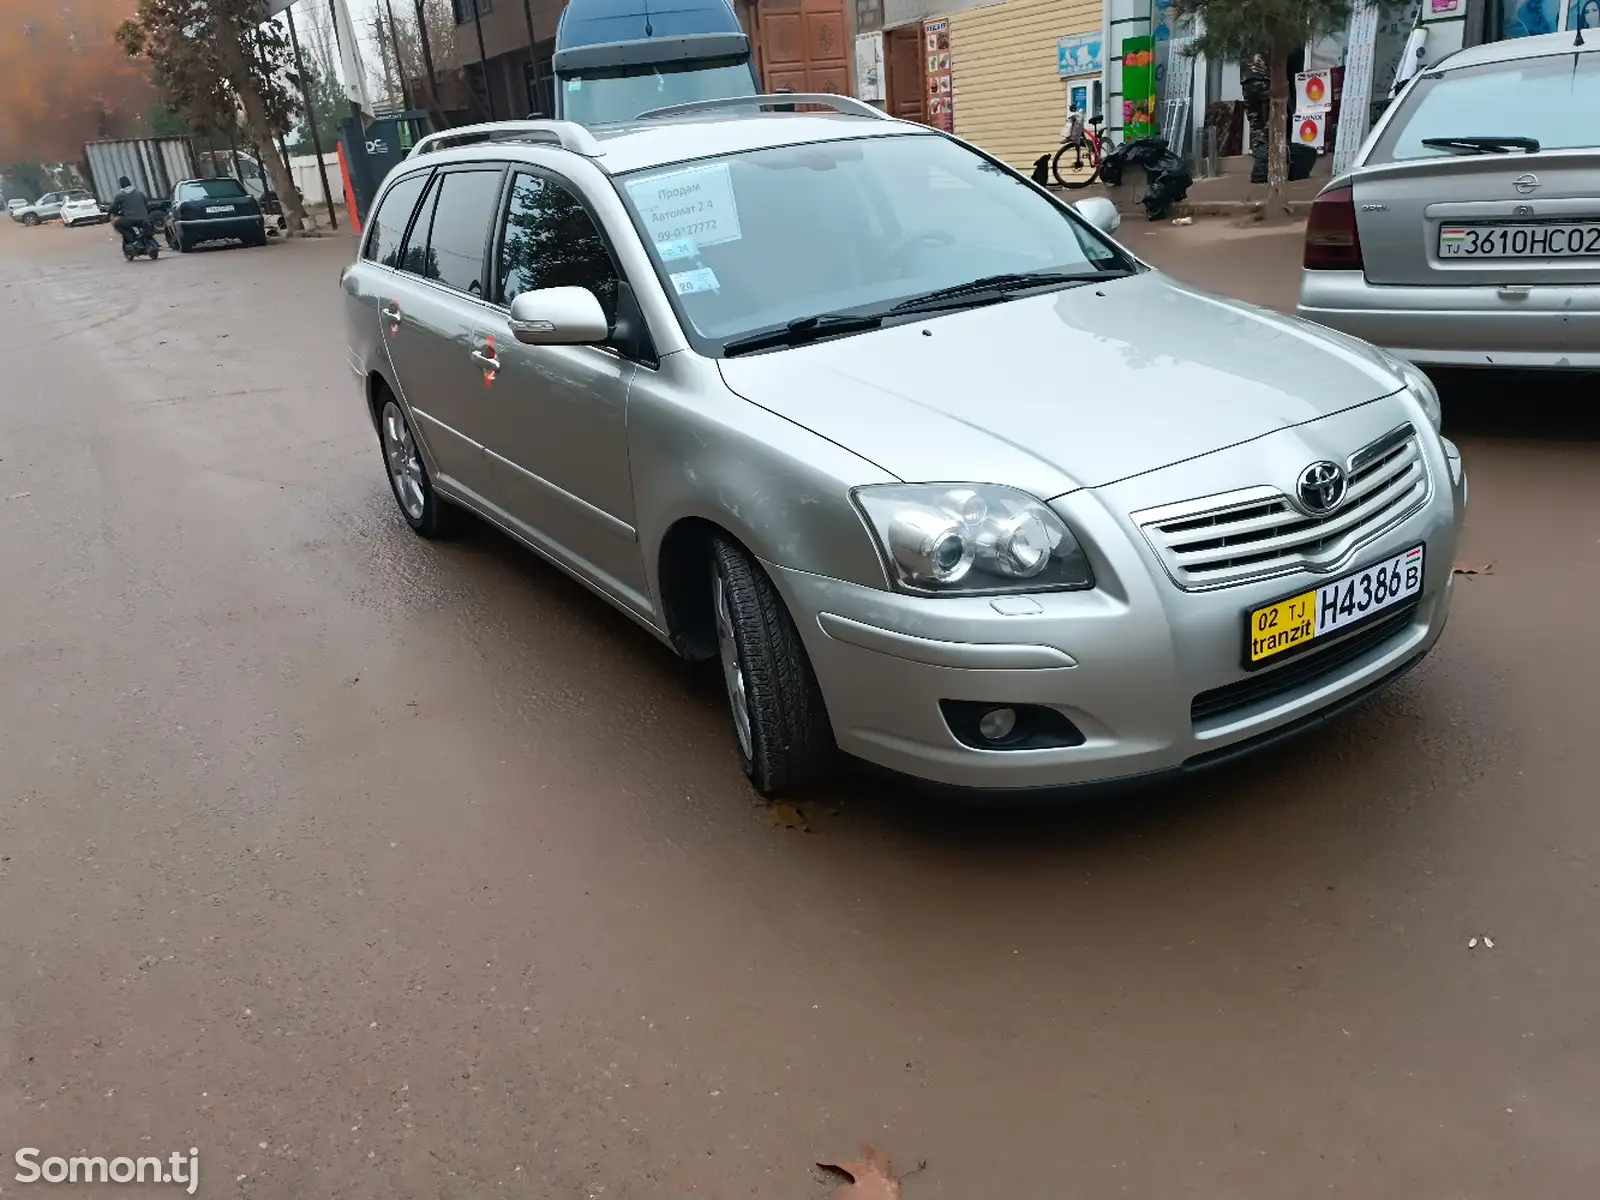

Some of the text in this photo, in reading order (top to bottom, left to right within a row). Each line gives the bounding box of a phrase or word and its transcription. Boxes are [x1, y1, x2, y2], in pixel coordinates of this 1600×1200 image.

[657, 183, 701, 200] Продам
[652, 204, 696, 222] Автомат
[1446, 244, 1460, 254] TJ
[1319, 559, 1402, 629] H4386
[1258, 601, 1306, 631] 02 TJ
[1252, 619, 1312, 656] tranzit
